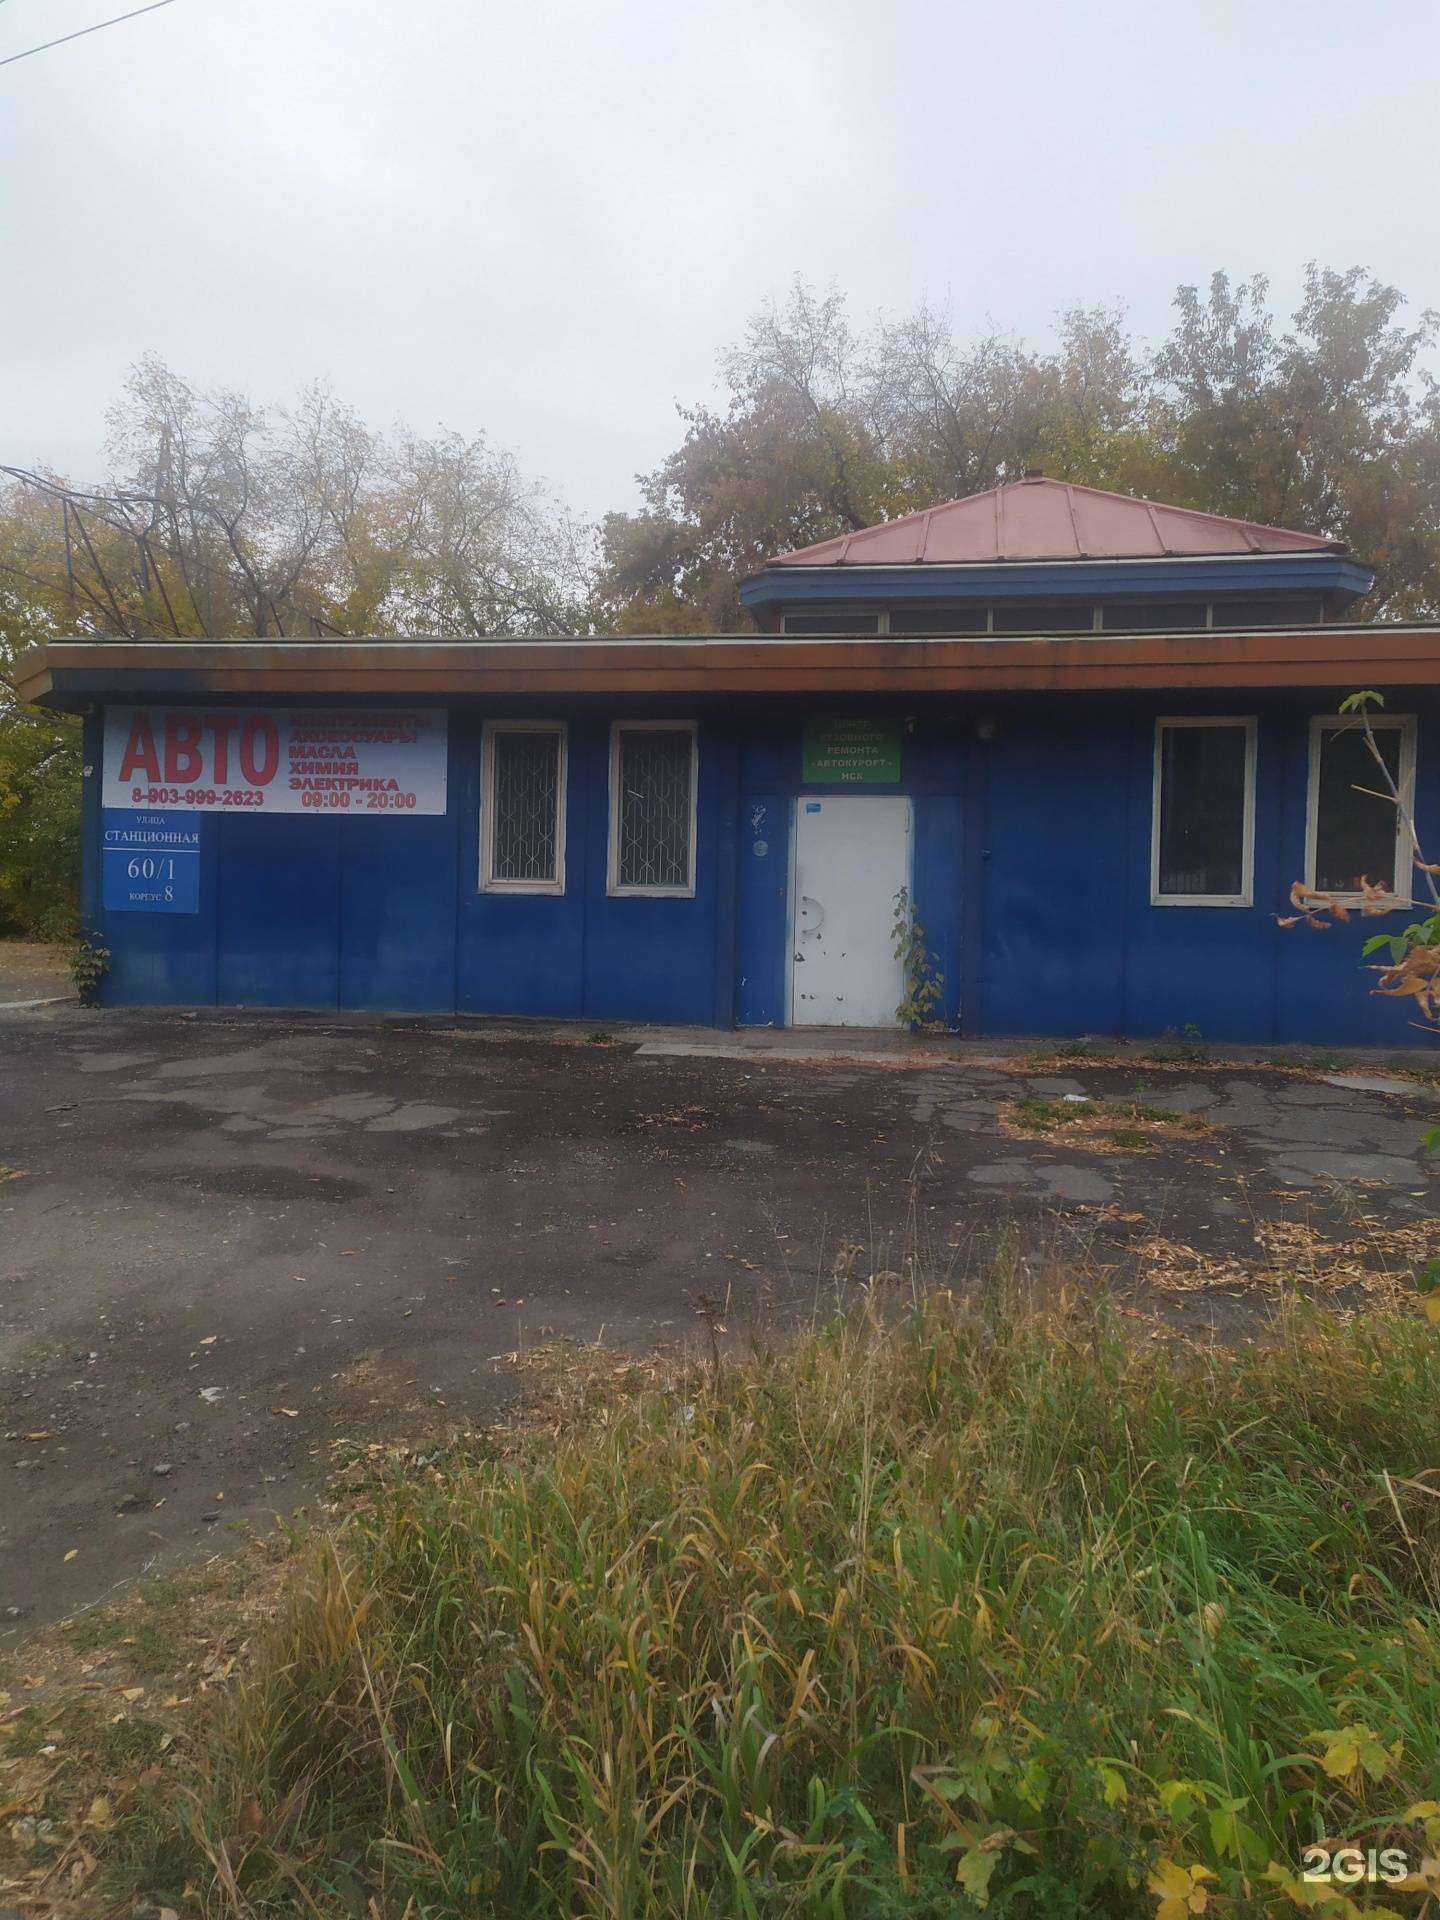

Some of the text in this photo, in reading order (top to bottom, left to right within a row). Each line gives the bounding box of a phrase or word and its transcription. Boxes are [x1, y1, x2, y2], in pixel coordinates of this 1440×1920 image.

[119, 713, 280, 786] АВТО
[288, 746, 357, 759] МАСЛА
[288, 761, 359, 775] ХИМИЯ
[288, 777, 400, 791] ЭЛЕКТРИКА
[301, 791, 351, 808] 09:00
[366, 792, 417, 809] 20:00
[105, 830, 199, 844] СТАНЦИОННАЯ
[127, 858, 175, 880] 60/1
[164, 885, 174, 902] 8
